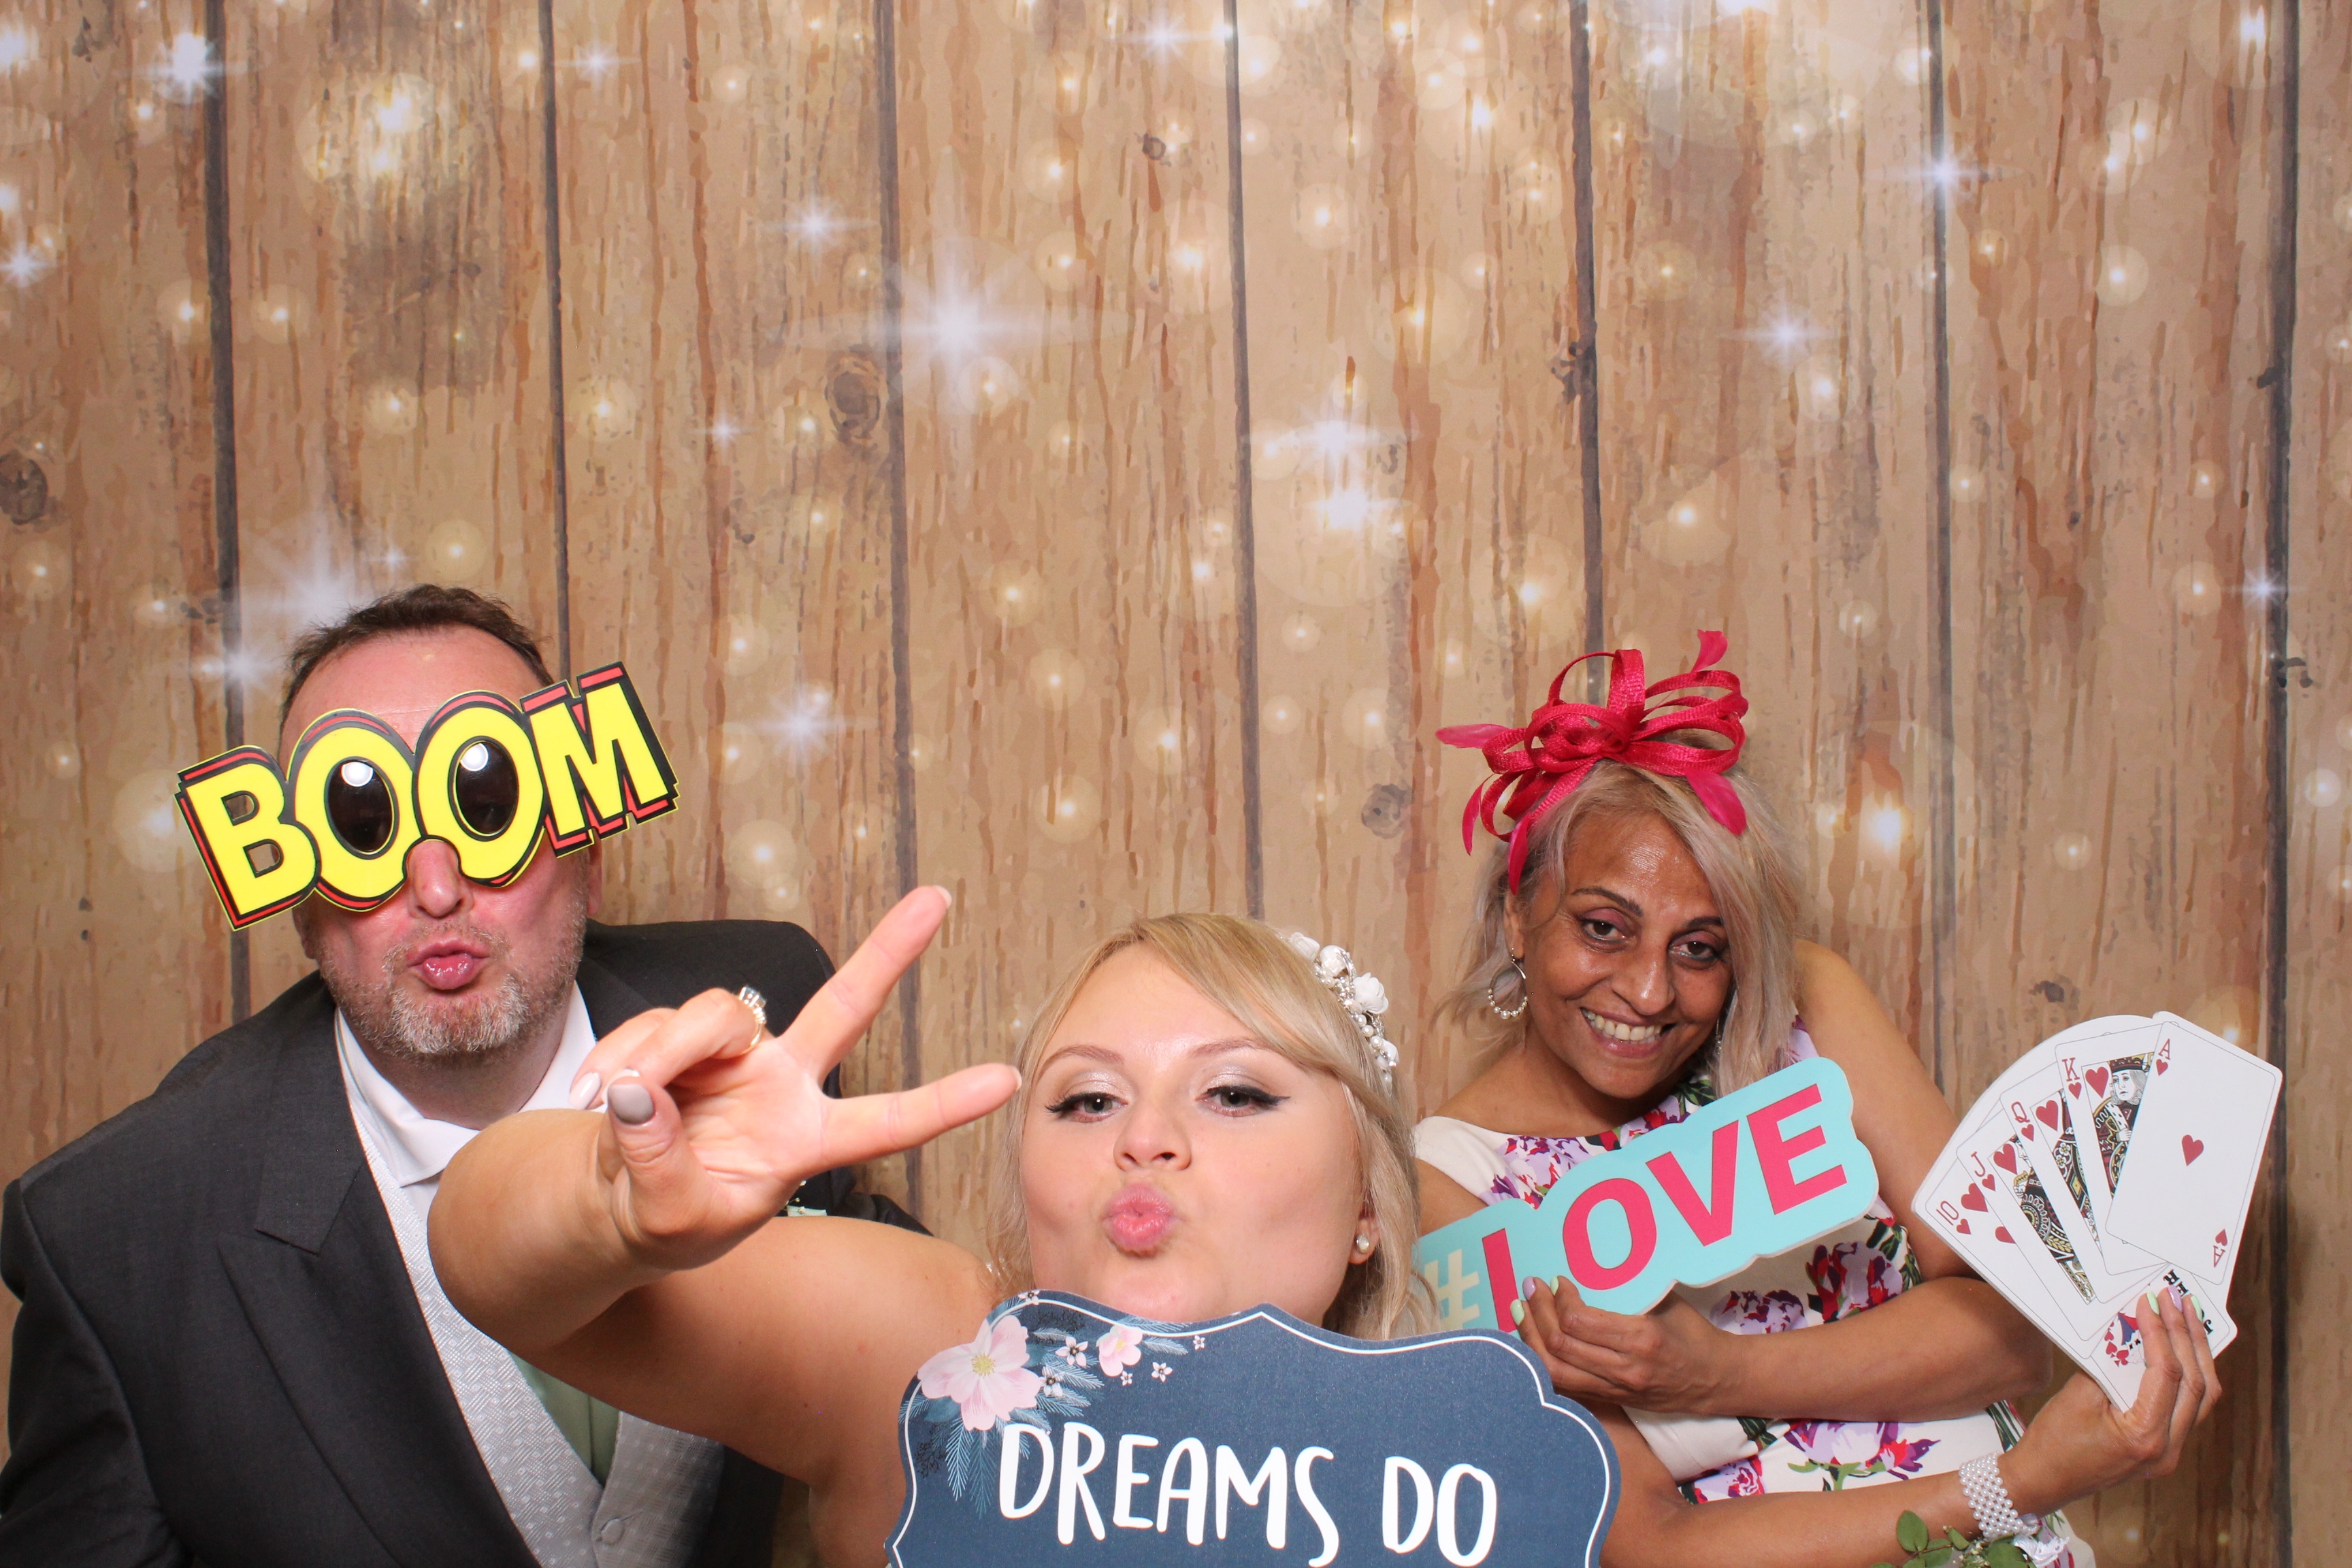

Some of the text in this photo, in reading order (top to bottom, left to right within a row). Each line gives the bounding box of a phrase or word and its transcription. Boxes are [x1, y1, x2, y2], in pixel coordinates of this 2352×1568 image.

[180, 670, 674, 924] BOOM
[2158, 1038, 2171, 1060] A
[2061, 1057, 2080, 1082] K
[2010, 1101, 2031, 1123] Q
[1970, 1152, 1986, 1177] J
[1936, 1200, 1959, 1226] 10
[2213, 1245, 2225, 1268] A
[999, 1422, 1497, 1567] DREAMS DO
